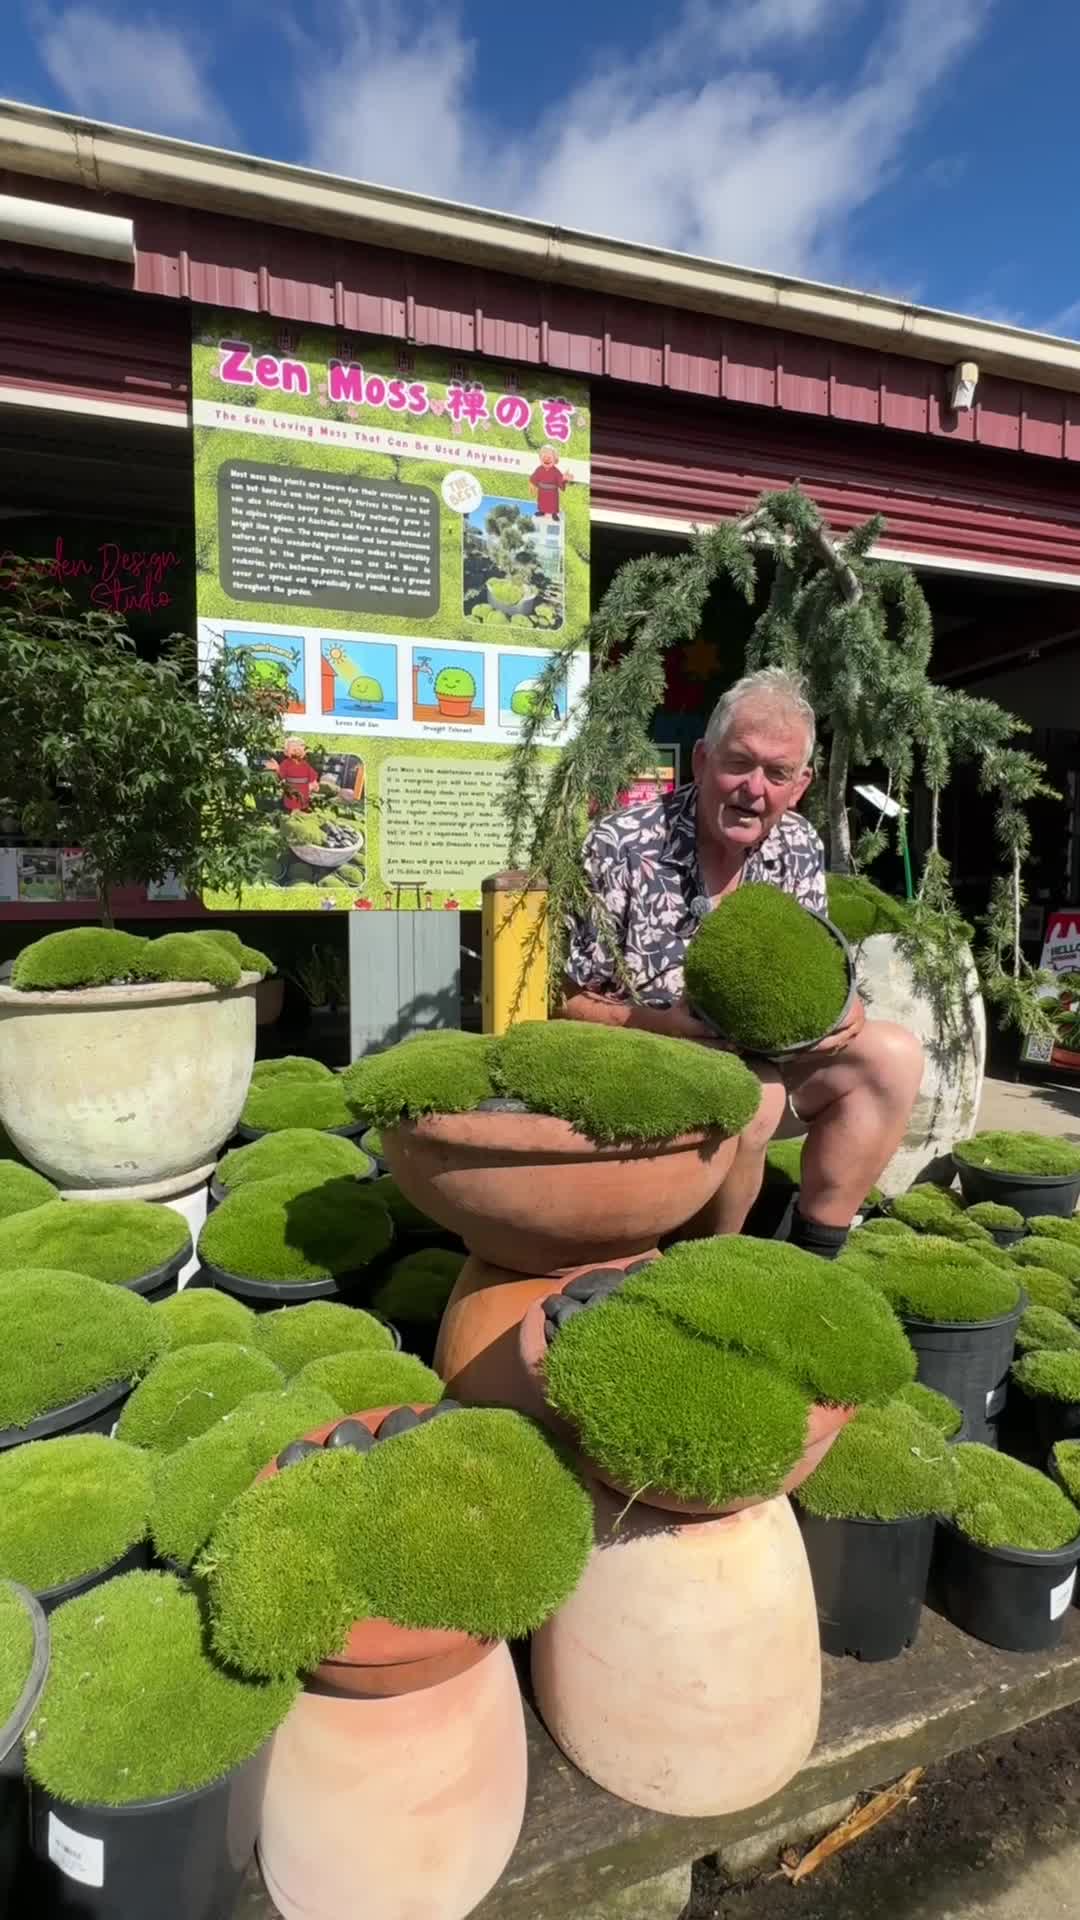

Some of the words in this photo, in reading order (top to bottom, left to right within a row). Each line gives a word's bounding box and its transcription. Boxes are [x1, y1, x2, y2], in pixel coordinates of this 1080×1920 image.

[219, 339, 310, 396] Zen
[328, 358, 428, 415] Moss
[215, 409, 236, 421] The
[244, 413, 266, 425] Sun
[273, 416, 313, 437] Loving
[320, 426, 347, 439] Moss
[355, 431, 380, 444] That
[388, 437, 408, 448] Can
[415, 441, 429, 451] Be
[435, 444, 460, 456] Used
[466, 450, 521, 466] Anywhere
[98, 543, 182, 583] Design
[90, 576, 171, 615] Studio
